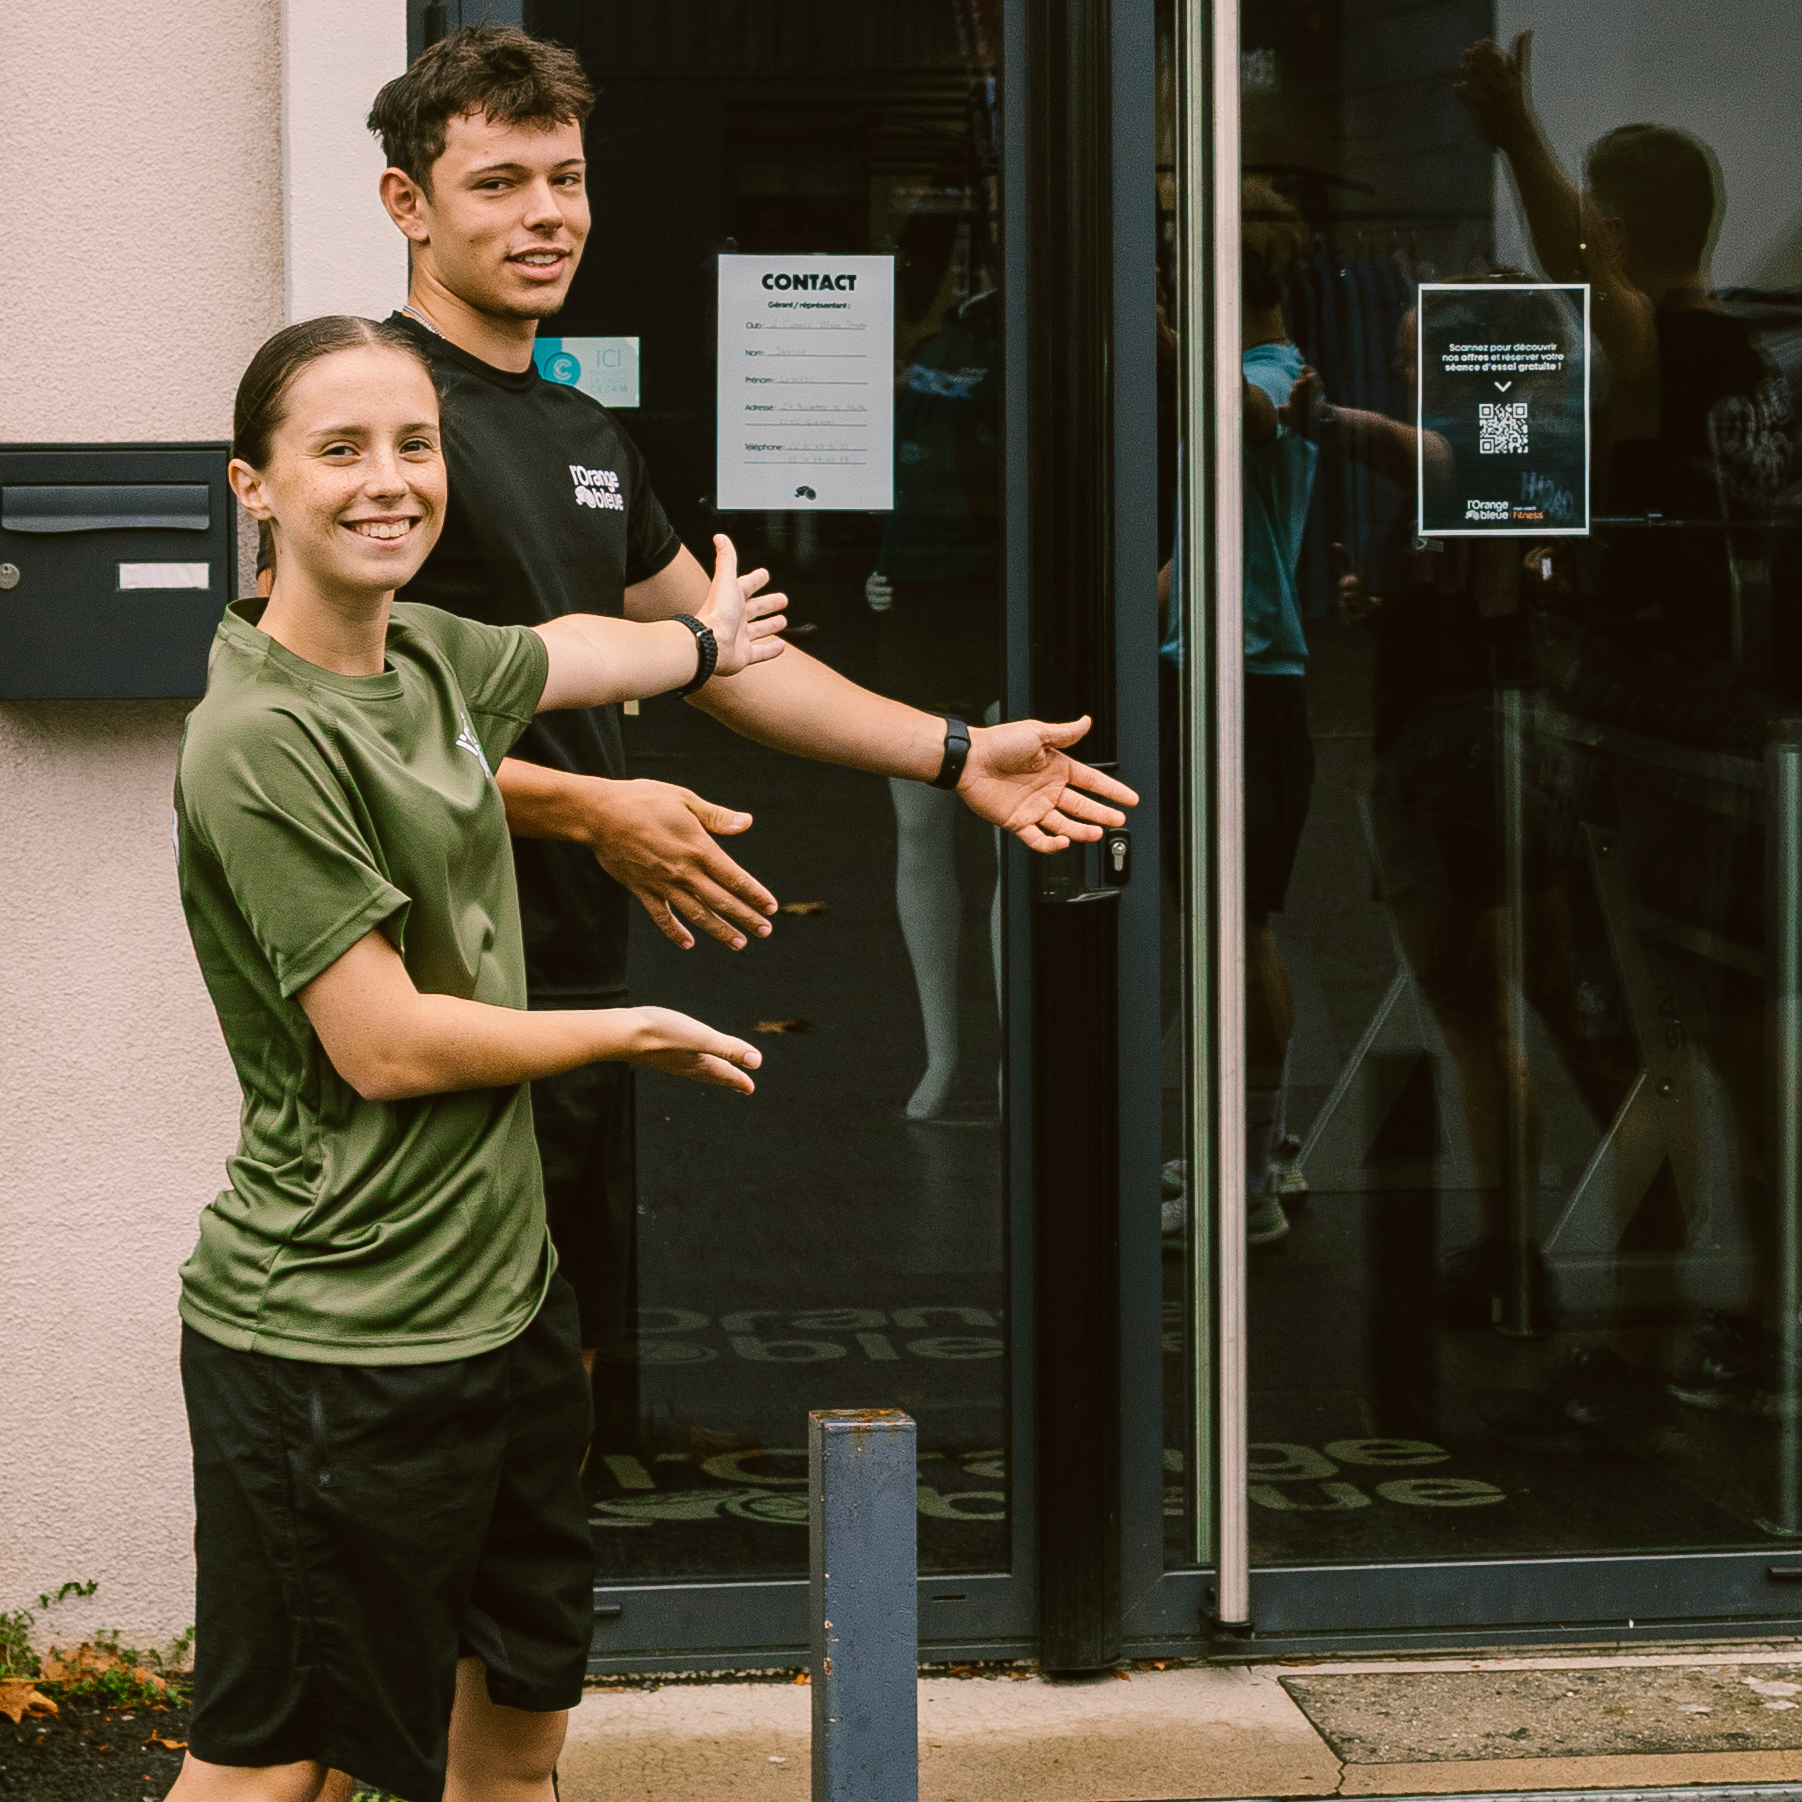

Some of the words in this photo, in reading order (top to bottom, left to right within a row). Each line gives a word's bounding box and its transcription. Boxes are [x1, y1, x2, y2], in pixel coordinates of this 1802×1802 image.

[761, 273, 857, 291] CONTACT
[767, 300, 793, 309] Gérant
[745, 321, 762, 330] Club
[1449, 343, 1488, 352] Scannez
[1490, 344, 1511, 353] pour
[1513, 343, 1557, 351] découvrir
[596, 348, 623, 368] ICI
[1460, 353, 1489, 361] offres
[1490, 353, 1500, 361] et
[1501, 353, 1539, 361] réserver
[1541, 353, 1565, 361] votre
[1445, 363, 1480, 371] séance
[1482, 362, 1517, 371] d'essai
[1518, 362, 1557, 372] gratuite
[568, 464, 620, 493] l'Orange
[591, 487, 624, 511] bleue
[1467, 499, 1509, 512] l'Orange
[1480, 510, 1509, 520] bleue
